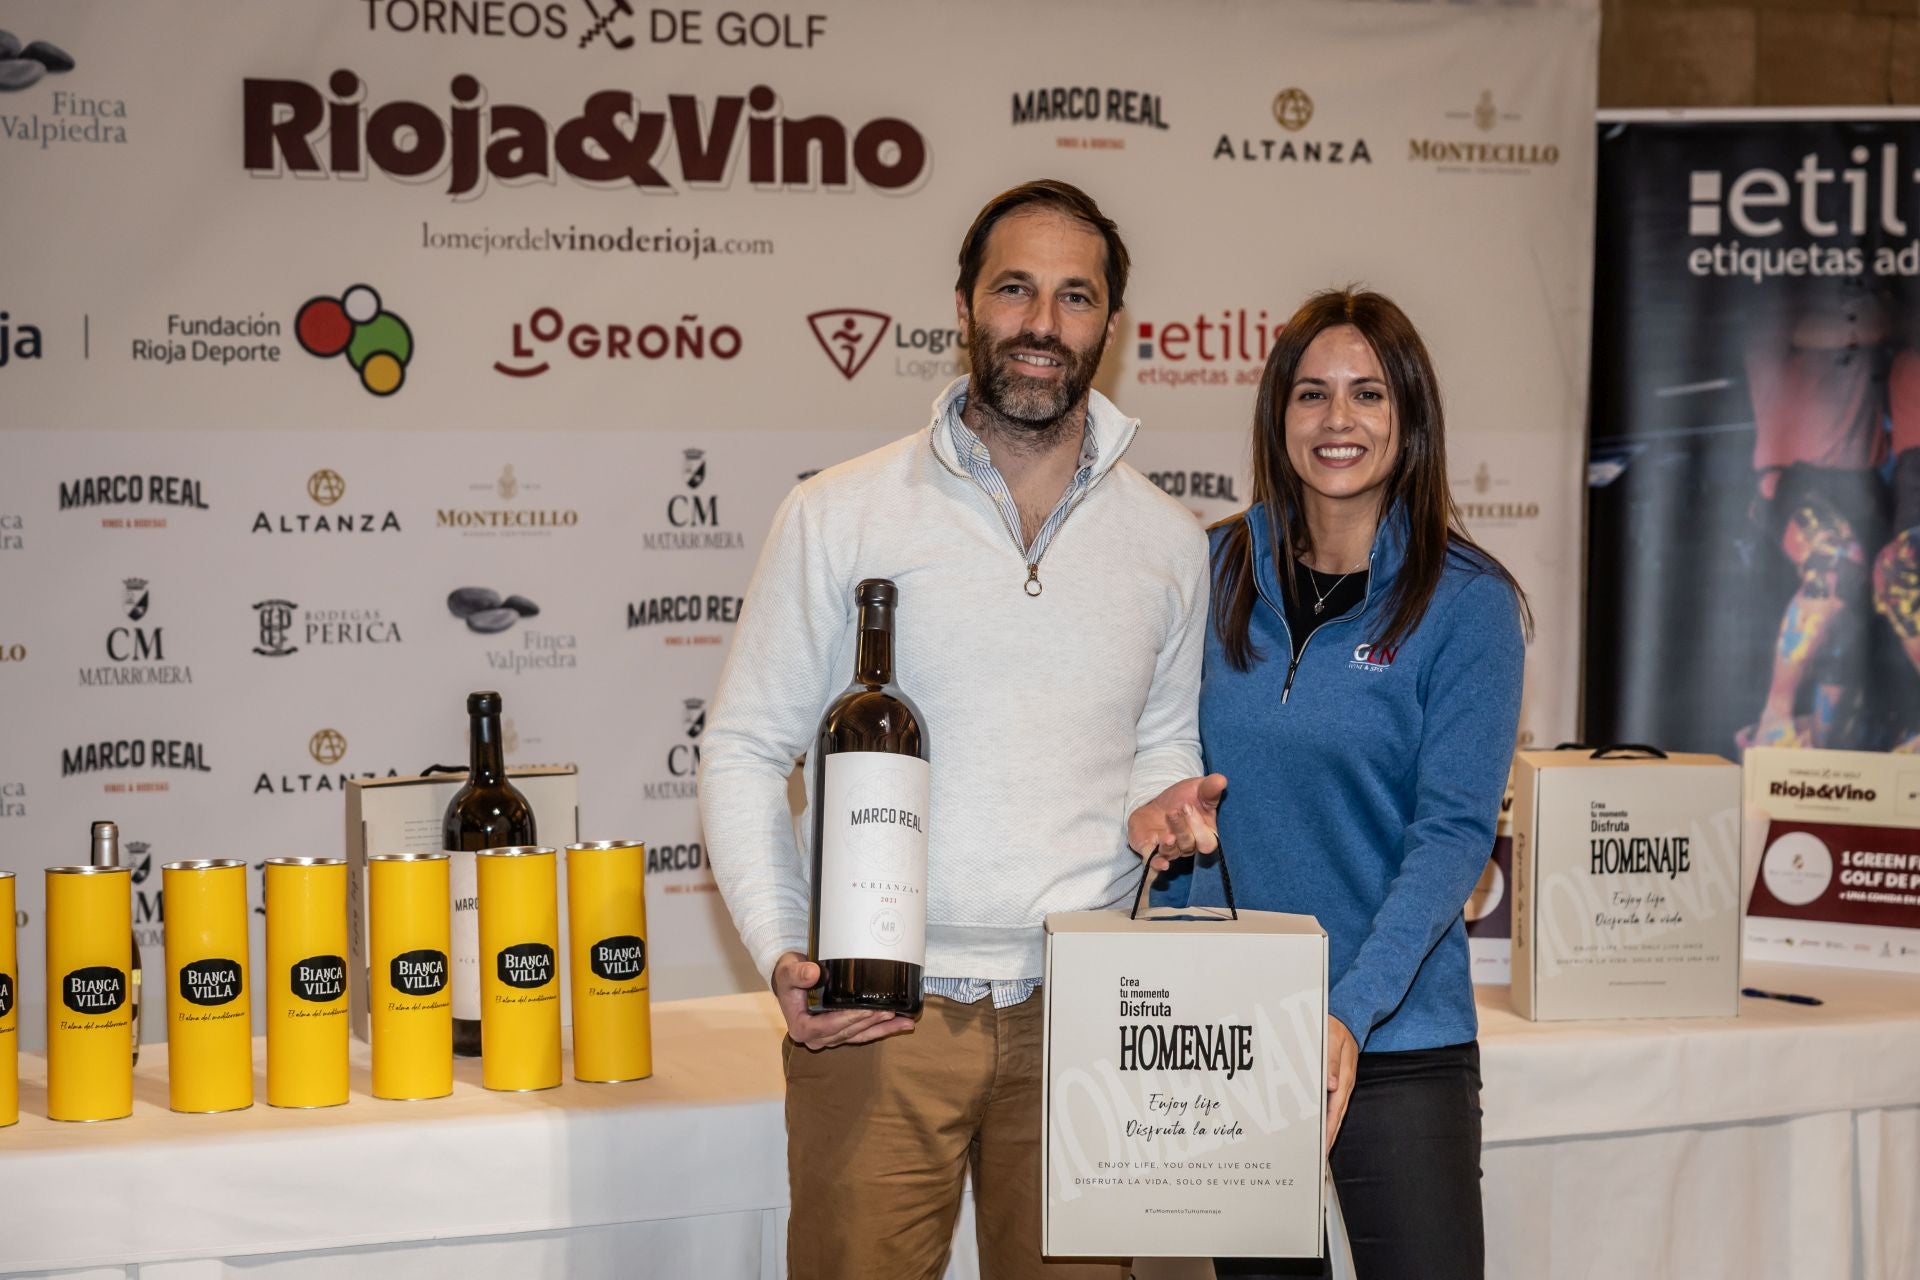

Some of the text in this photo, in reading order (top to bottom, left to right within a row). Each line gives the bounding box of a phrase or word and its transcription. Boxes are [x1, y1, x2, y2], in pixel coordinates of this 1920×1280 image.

[367, 0, 828, 48] TORNEOS DE GOLF
[52, 91, 127, 118] Finca
[1012, 86, 1169, 131] MARCO REAL
[0, 114, 128, 149] Valpiedra
[243, 69, 930, 198] Rioja&Vino
[1213, 134, 1373, 164] ALTANZA
[1408, 138, 1560, 166] MONTECILLO
[1727, 143, 1920, 237] etil
[422, 221, 775, 260] lomejordelvinoderioja.com
[1688, 240, 1864, 284] etiquetas
[168, 313, 281, 337] Fundación
[513, 305, 743, 361] LOGROÑO
[132, 339, 281, 365] Rioja Deporte
[895, 357, 957, 381] Logro
[1137, 367, 1229, 388] etiquetas
[59, 475, 209, 511] MARCO REAL
[1190, 471, 1238, 502] REAL
[252, 510, 401, 534] ALTANZA
[436, 508, 578, 528] MONTECILLO
[667, 495, 720, 527] CM
[642, 531, 745, 550] MATARROMERA
[305, 609, 381, 621] BODEGAS
[627, 595, 701, 630] MARCO
[306, 621, 402, 644] PERICA
[523, 630, 577, 650] Finca
[105, 627, 165, 661] CM
[486, 650, 577, 674] Valpiedra
[79, 666, 193, 686] MATARROMERA
[62, 739, 211, 778] MARCO REAL
[1769, 780, 1877, 802] Rioja&Vino
[851, 807, 923, 834] MARCO REAL
[1591, 820, 1630, 832] Disfruta
[645, 842, 702, 874] ARCO
[1590, 836, 1691, 880] HOMENAJE
[1852, 851, 1907, 870] GREEN
[860, 880, 914, 894] CRIANZA
[1840, 869, 1884, 888] GOLF
[1885, 871, 1909, 889] DE
[881, 921, 896, 932] MR
[505, 953, 550, 970] BIANCA
[599, 946, 641, 962] BIANCA
[187, 970, 236, 986] BIANCA
[299, 966, 343, 982] BIANCA
[399, 960, 444, 976] BIANCA
[509, 968, 547, 982] VILLA
[603, 960, 639, 975] VILLA
[71, 978, 119, 995] BIANCA
[192, 985, 233, 999] VILLA
[304, 981, 341, 995] VILLA
[403, 975, 441, 989] VILLA
[1120, 976, 1140, 987] Crea
[76, 993, 116, 1007] VILLA
[1119, 988, 1170, 999] tu momento
[1119, 1001, 1172, 1017] Disfruta
[1119, 1024, 1254, 1081] HOMENAJE
[1149, 1093, 1222, 1117] Enjoy life
[1126, 1119, 1244, 1142] Disfruta la vida
[1098, 1161, 1272, 1171] ENJOY LIFE, YOU ONLY LIVE ONCE
[1075, 1177, 1294, 1187] DISFRUTA LA VIDA, SOLO SE VIVE UNA VEZ
